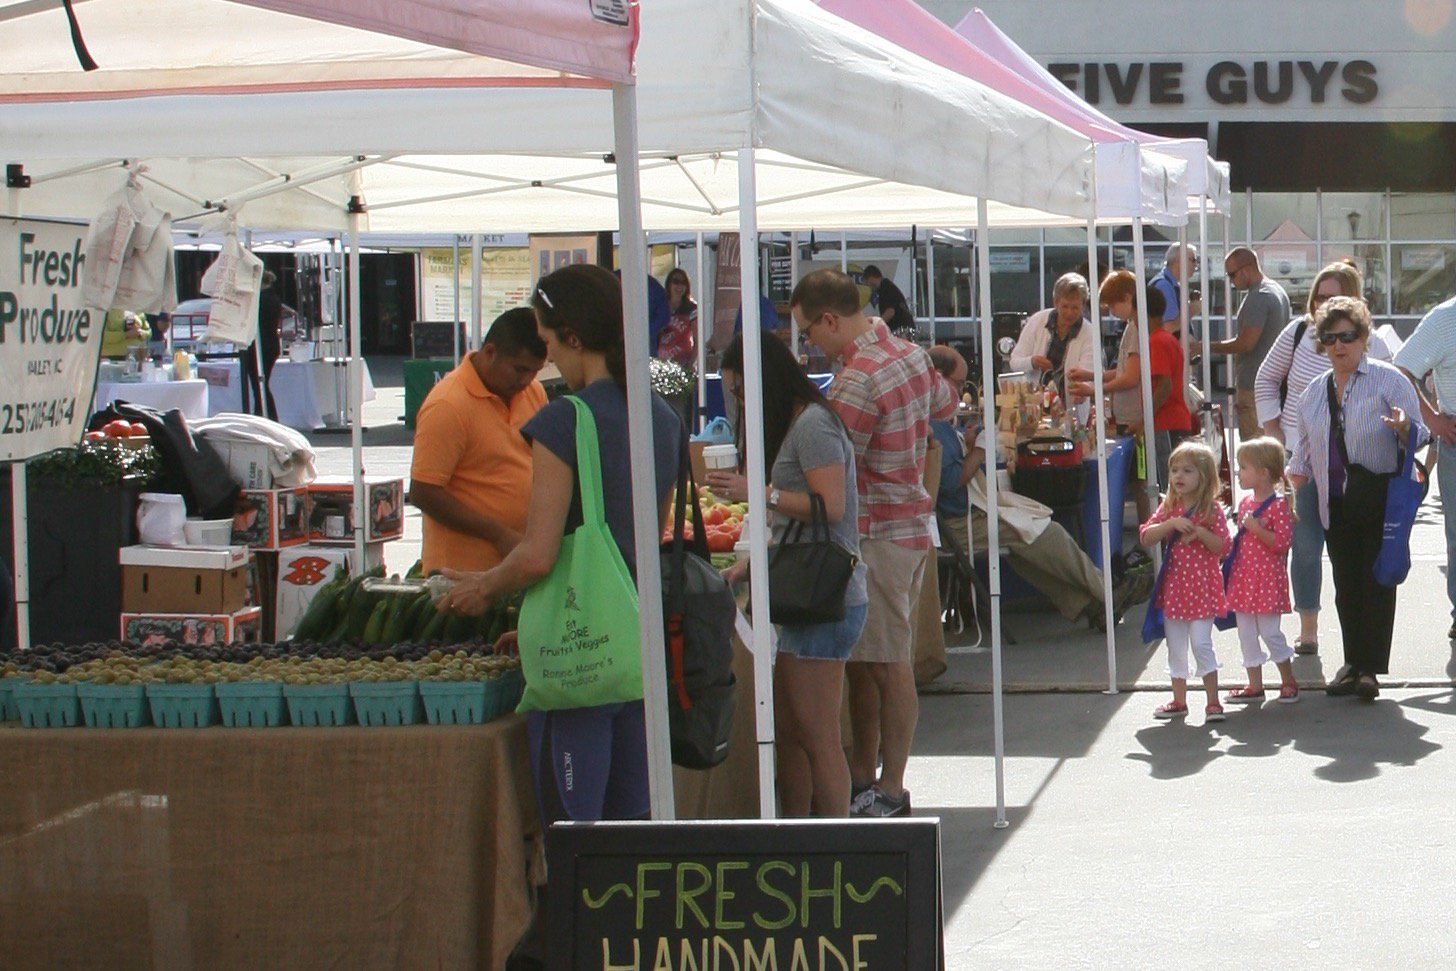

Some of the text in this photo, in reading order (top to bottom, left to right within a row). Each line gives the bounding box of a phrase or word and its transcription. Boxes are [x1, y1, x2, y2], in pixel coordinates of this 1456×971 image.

[1048, 60, 1379, 105] FIVE GUYS
[20, 232, 86, 288] Fresh
[0, 291, 91, 345] Produce
[575, 634, 609, 651] Veggies
[636, 860, 843, 929] FRESH
[602, 933, 878, 971] HANDMADE
